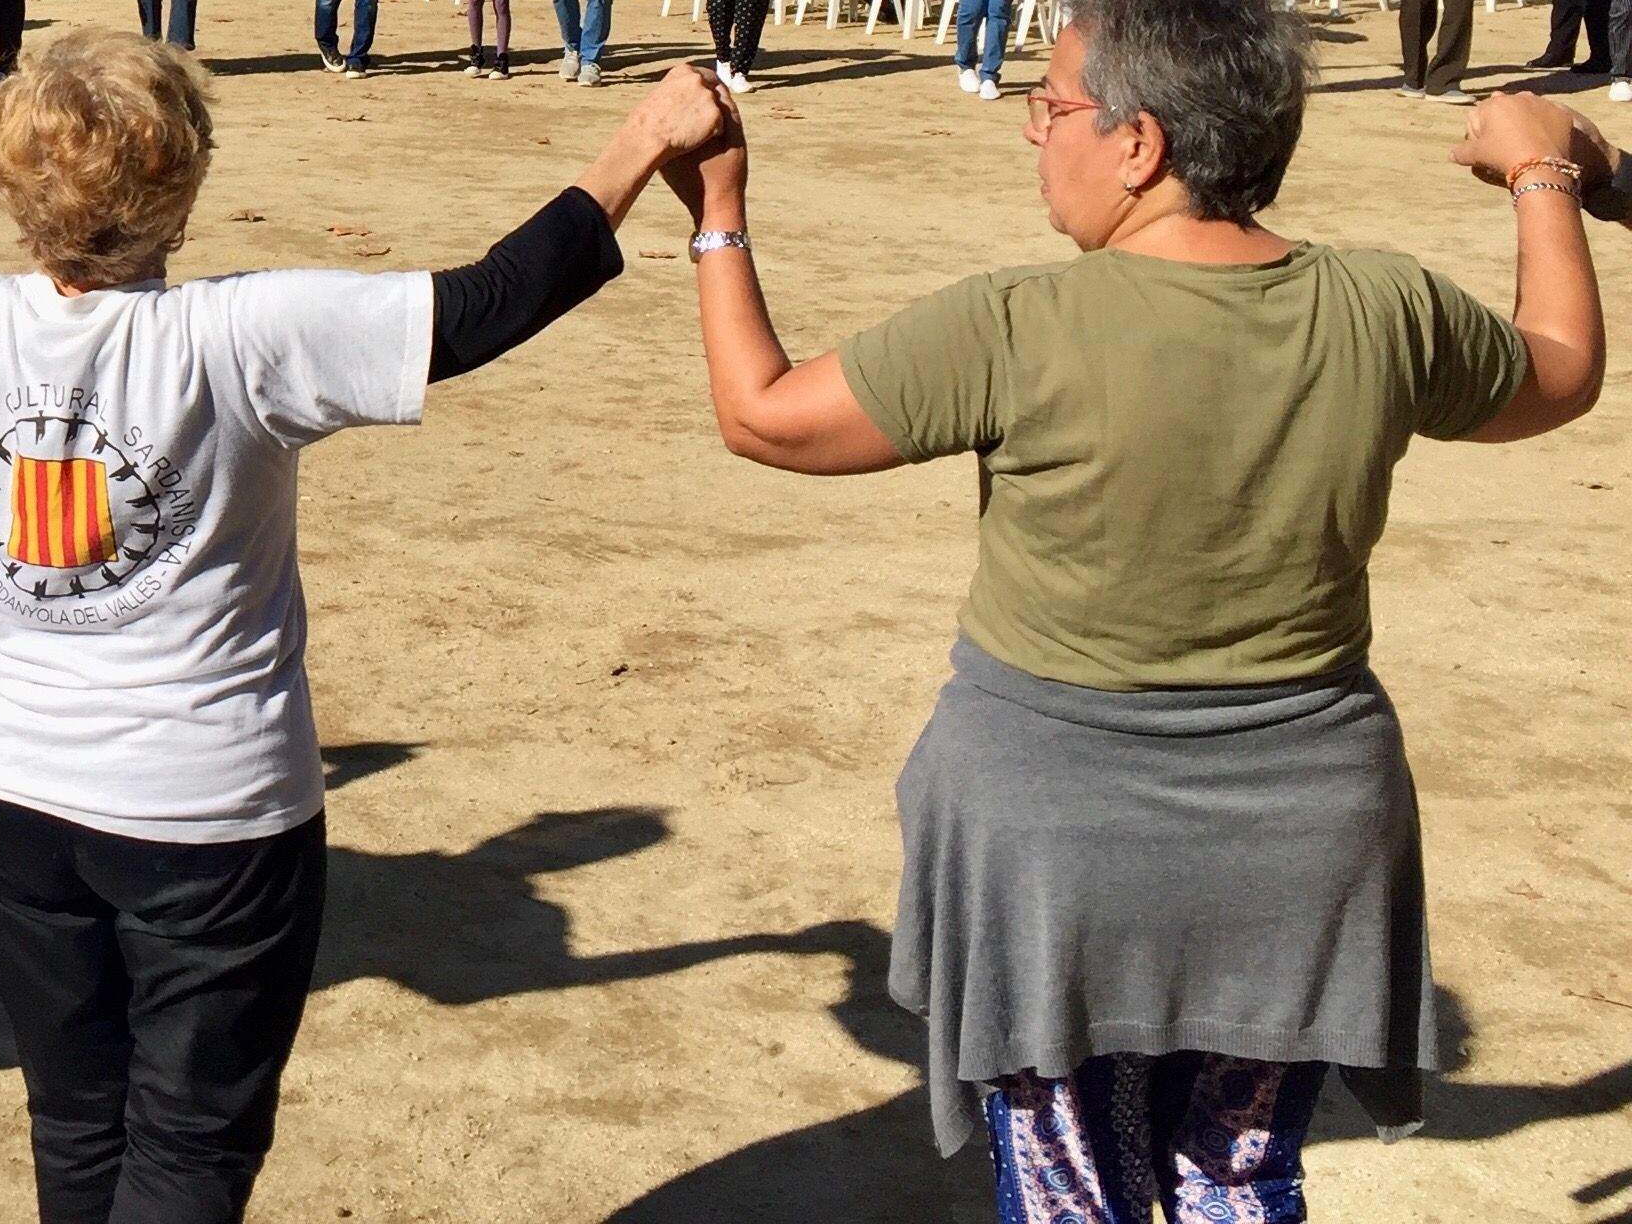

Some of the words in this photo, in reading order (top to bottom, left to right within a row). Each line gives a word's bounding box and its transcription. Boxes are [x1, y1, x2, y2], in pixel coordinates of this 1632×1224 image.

[123, 425, 196, 565] SARDANISTA
[73, 606, 108, 625] DEL
[105, 574, 162, 618] VALLÈS
